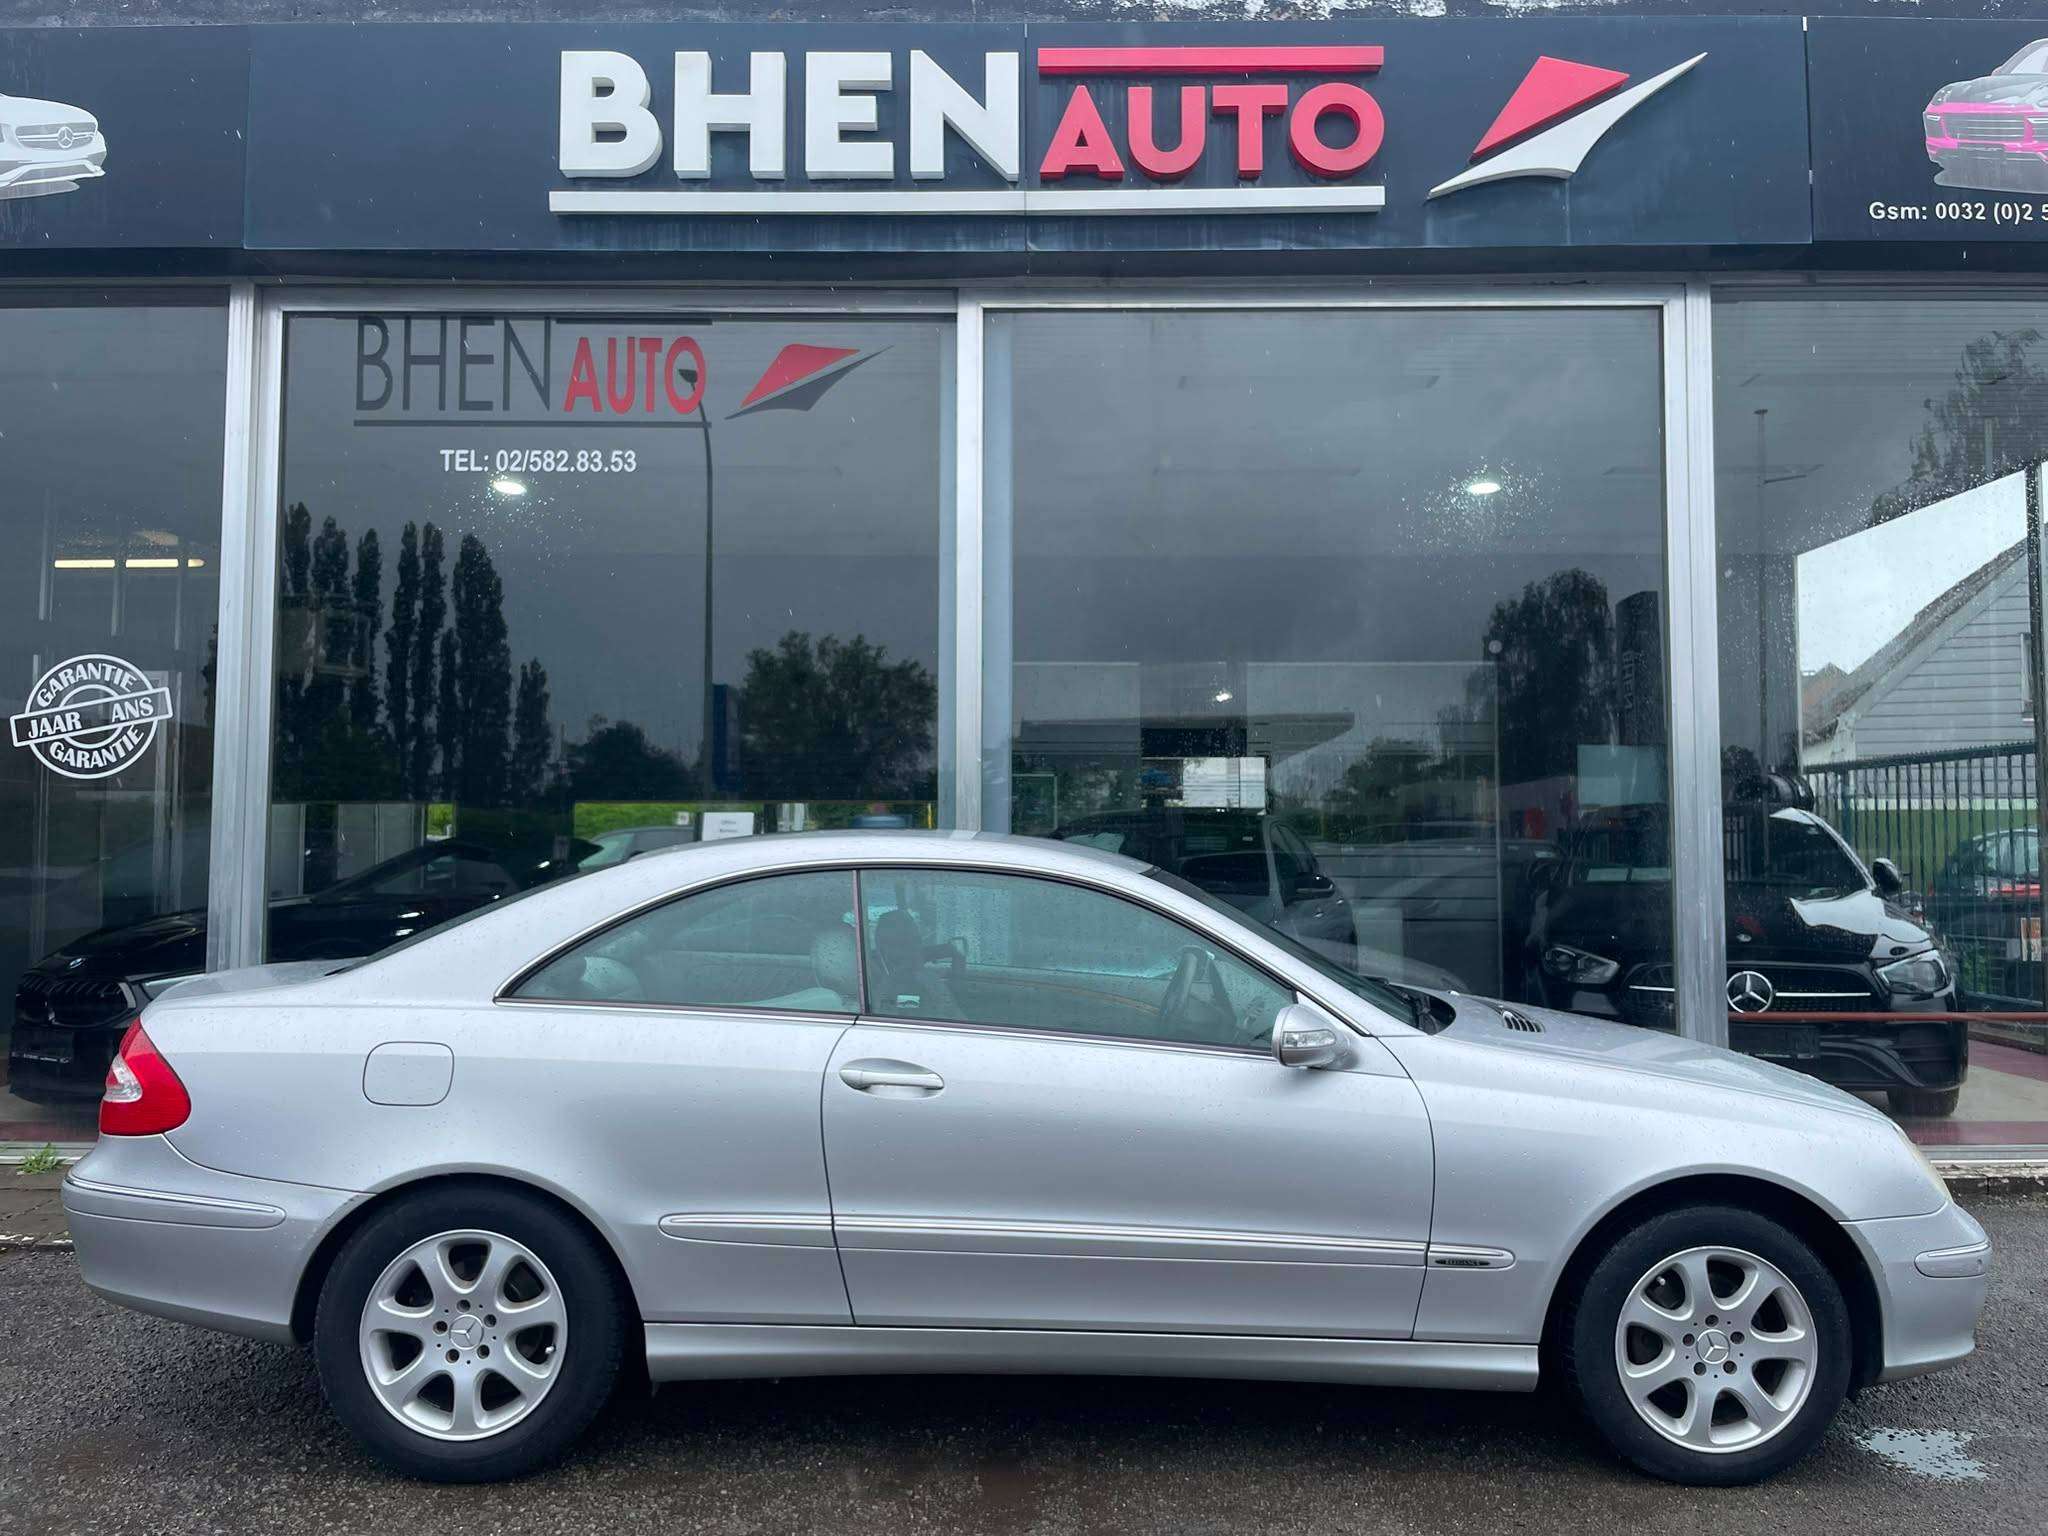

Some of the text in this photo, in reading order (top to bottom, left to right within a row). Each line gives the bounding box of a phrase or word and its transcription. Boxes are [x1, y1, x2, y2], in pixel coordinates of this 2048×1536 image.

[558, 50, 1385, 182] BHEN AUTO
[1869, 201, 1927, 220] Gsm:
[1935, 202, 1986, 220] 0032
[1994, 202, 2033, 224] (0)2
[355, 316, 706, 414] BHEN AUTO
[440, 449, 637, 472] TEL: 02/582.83.53
[36, 662, 137, 707] GARANTIE
[28, 697, 154, 739] JAAR ANS
[50, 724, 144, 769] GARANTIE
